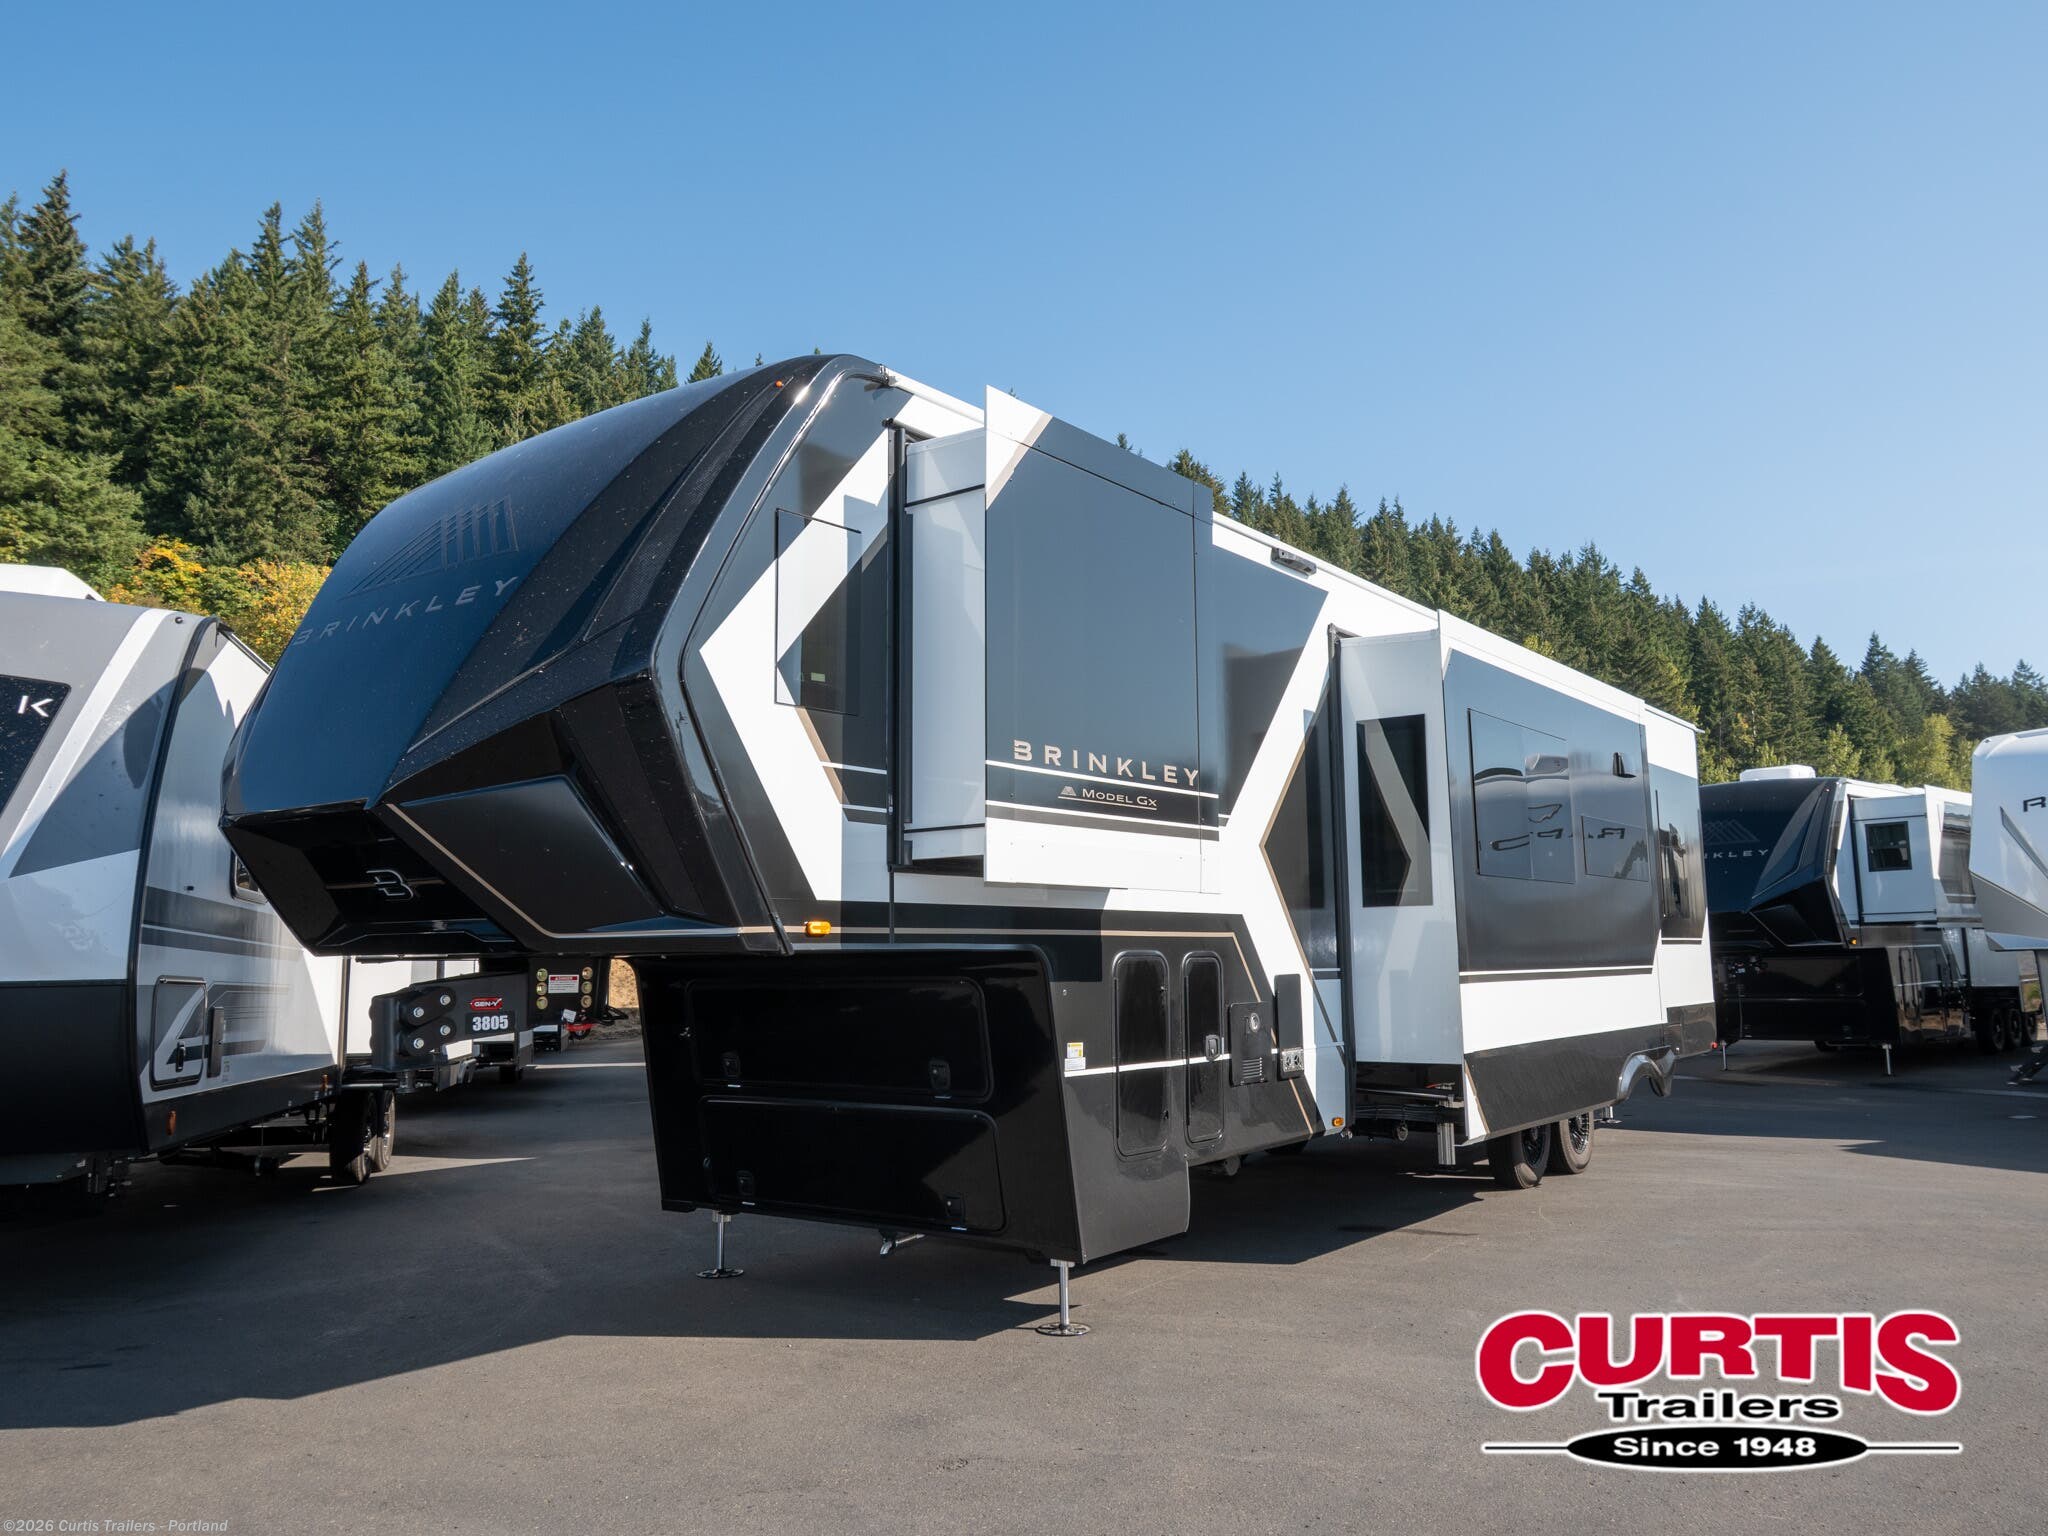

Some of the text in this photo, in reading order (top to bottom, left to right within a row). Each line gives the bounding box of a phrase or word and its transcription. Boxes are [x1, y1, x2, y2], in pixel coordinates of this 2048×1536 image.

[291, 577, 518, 646] BRINKLEY
[1013, 739, 1199, 787] BRINKLEY
[1082, 788, 1133, 804] MODEL
[472, 1015, 509, 1031] 3805
